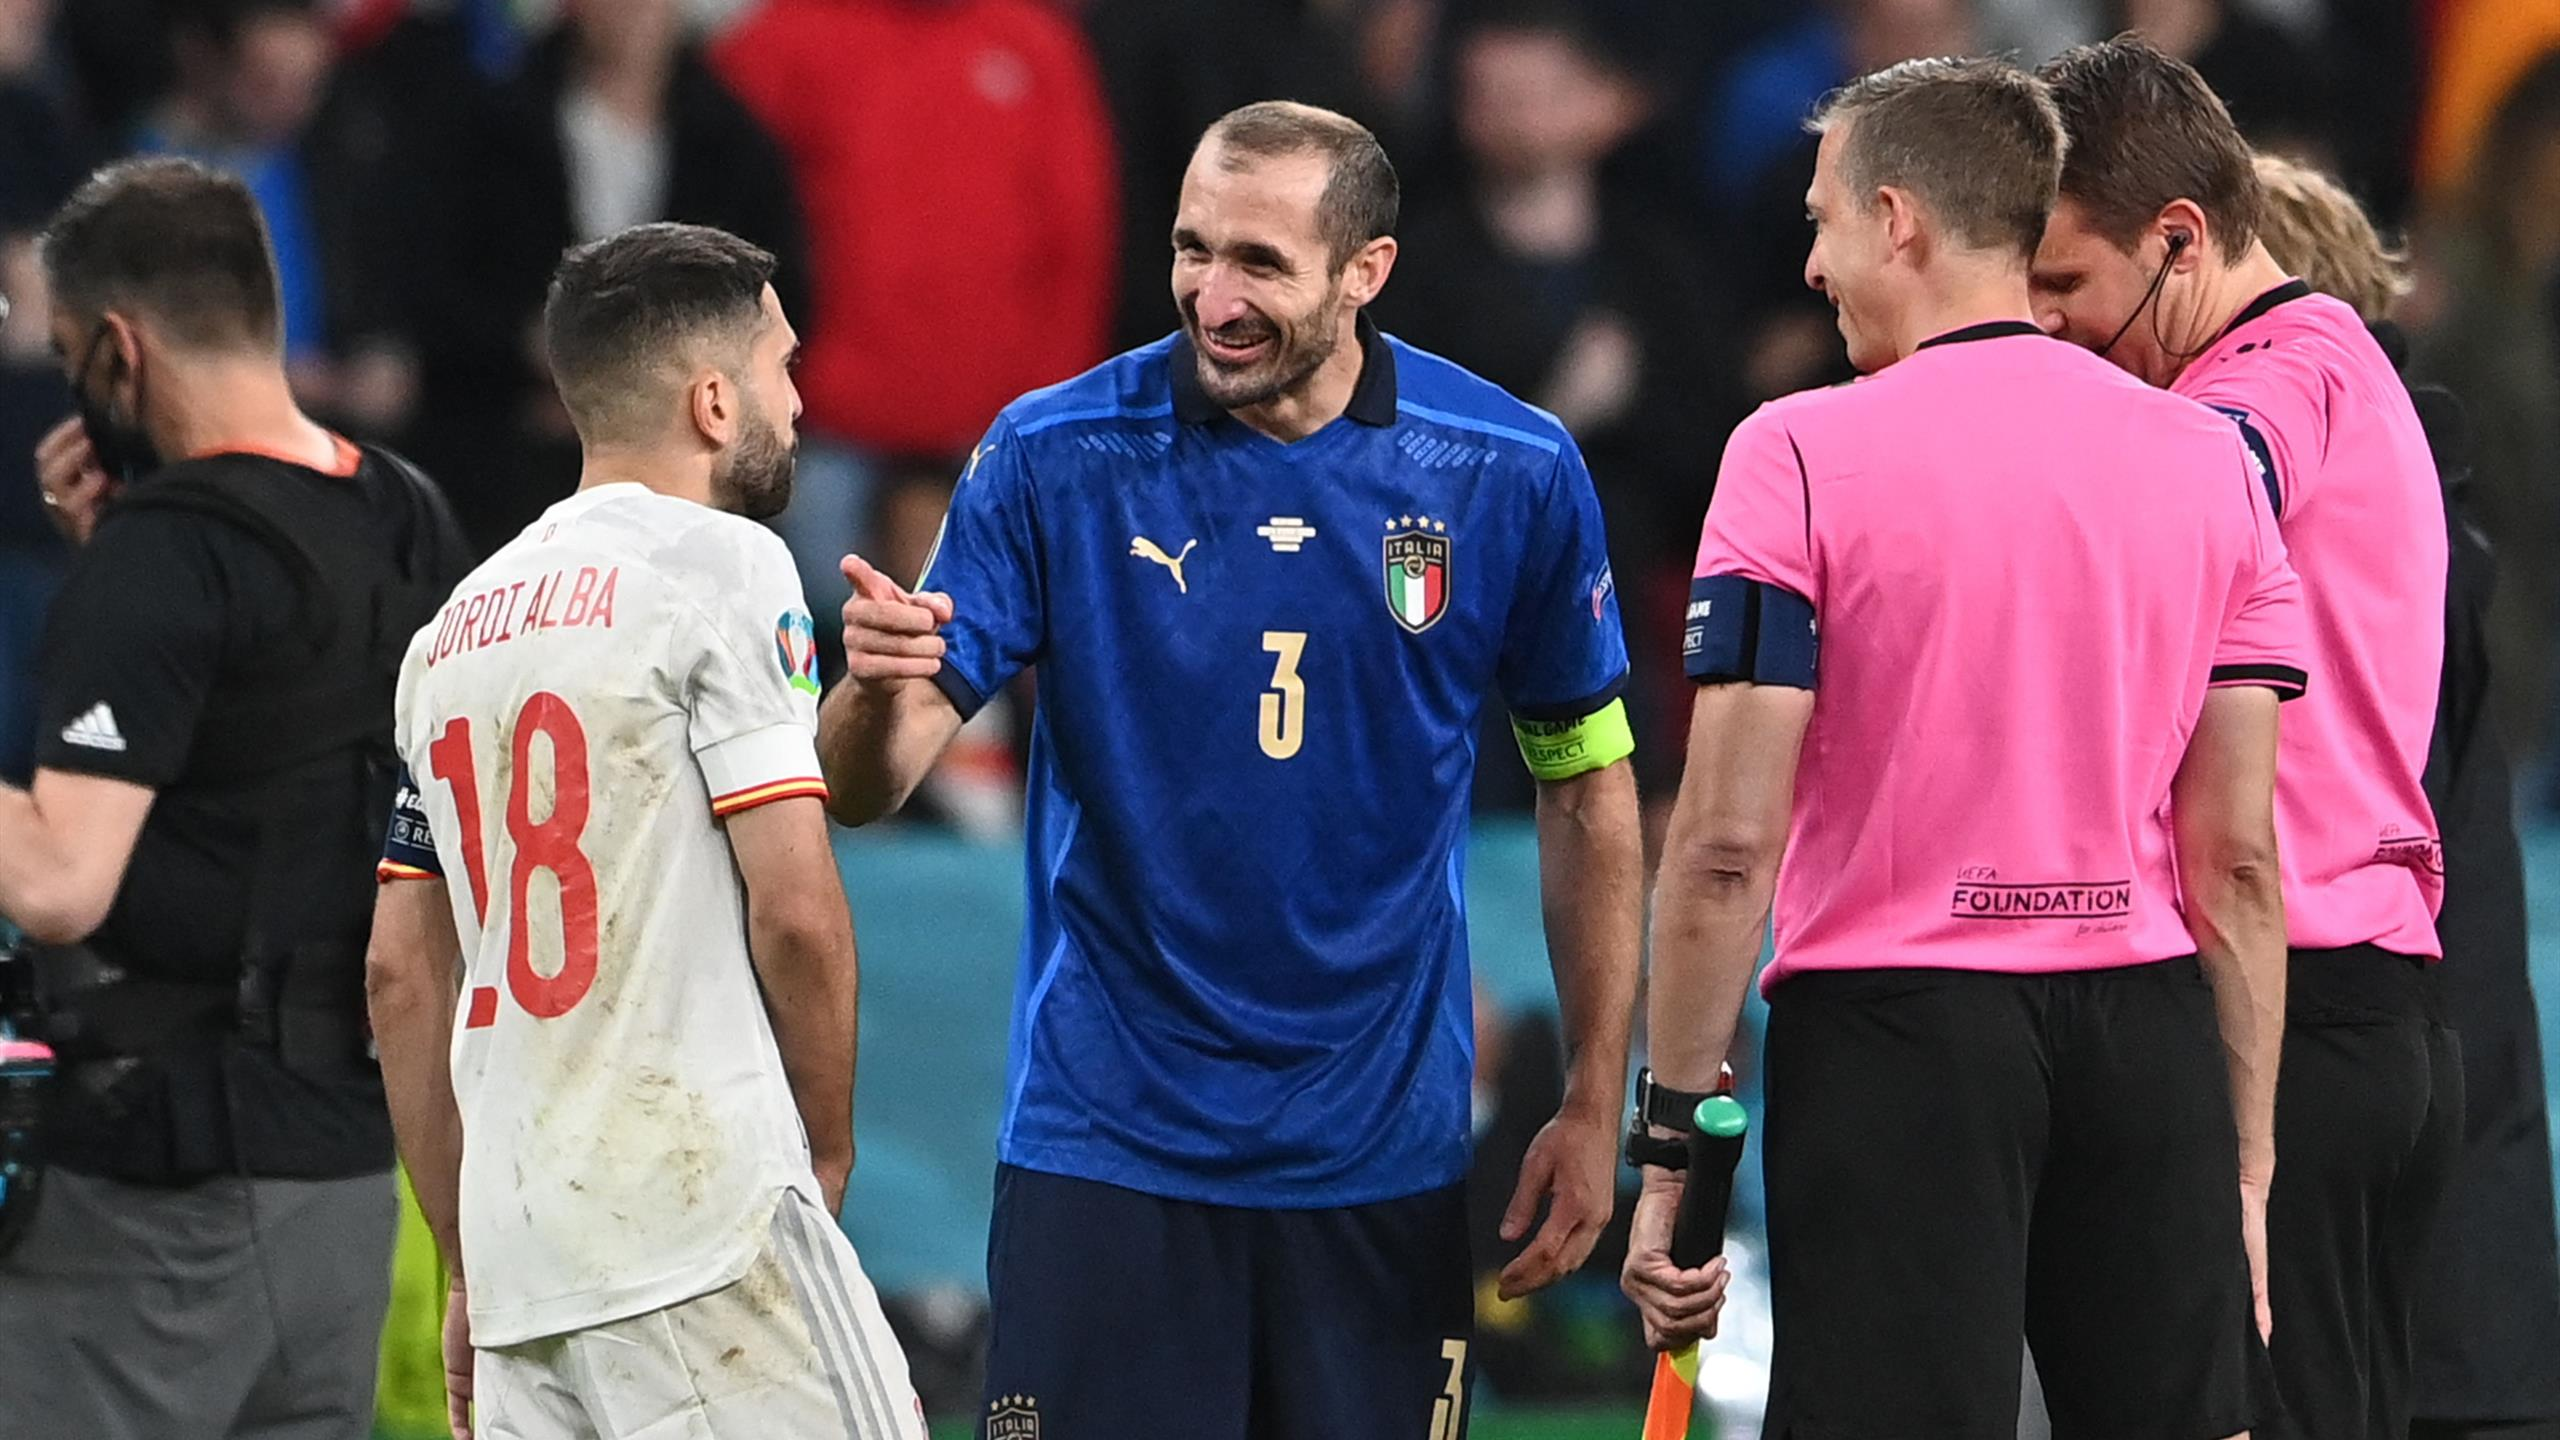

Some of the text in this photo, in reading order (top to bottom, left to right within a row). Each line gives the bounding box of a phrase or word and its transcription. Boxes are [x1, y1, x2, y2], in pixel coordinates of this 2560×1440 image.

[1388, 541, 1442, 557] ITALIA
[426, 566, 619, 668] JORDI ALBA
[1258, 631, 1308, 760] 3
[430, 691, 599, 1029] 18
[1952, 887, 2131, 912] FOUNDATION
[1428, 1338, 1468, 1440] 3
